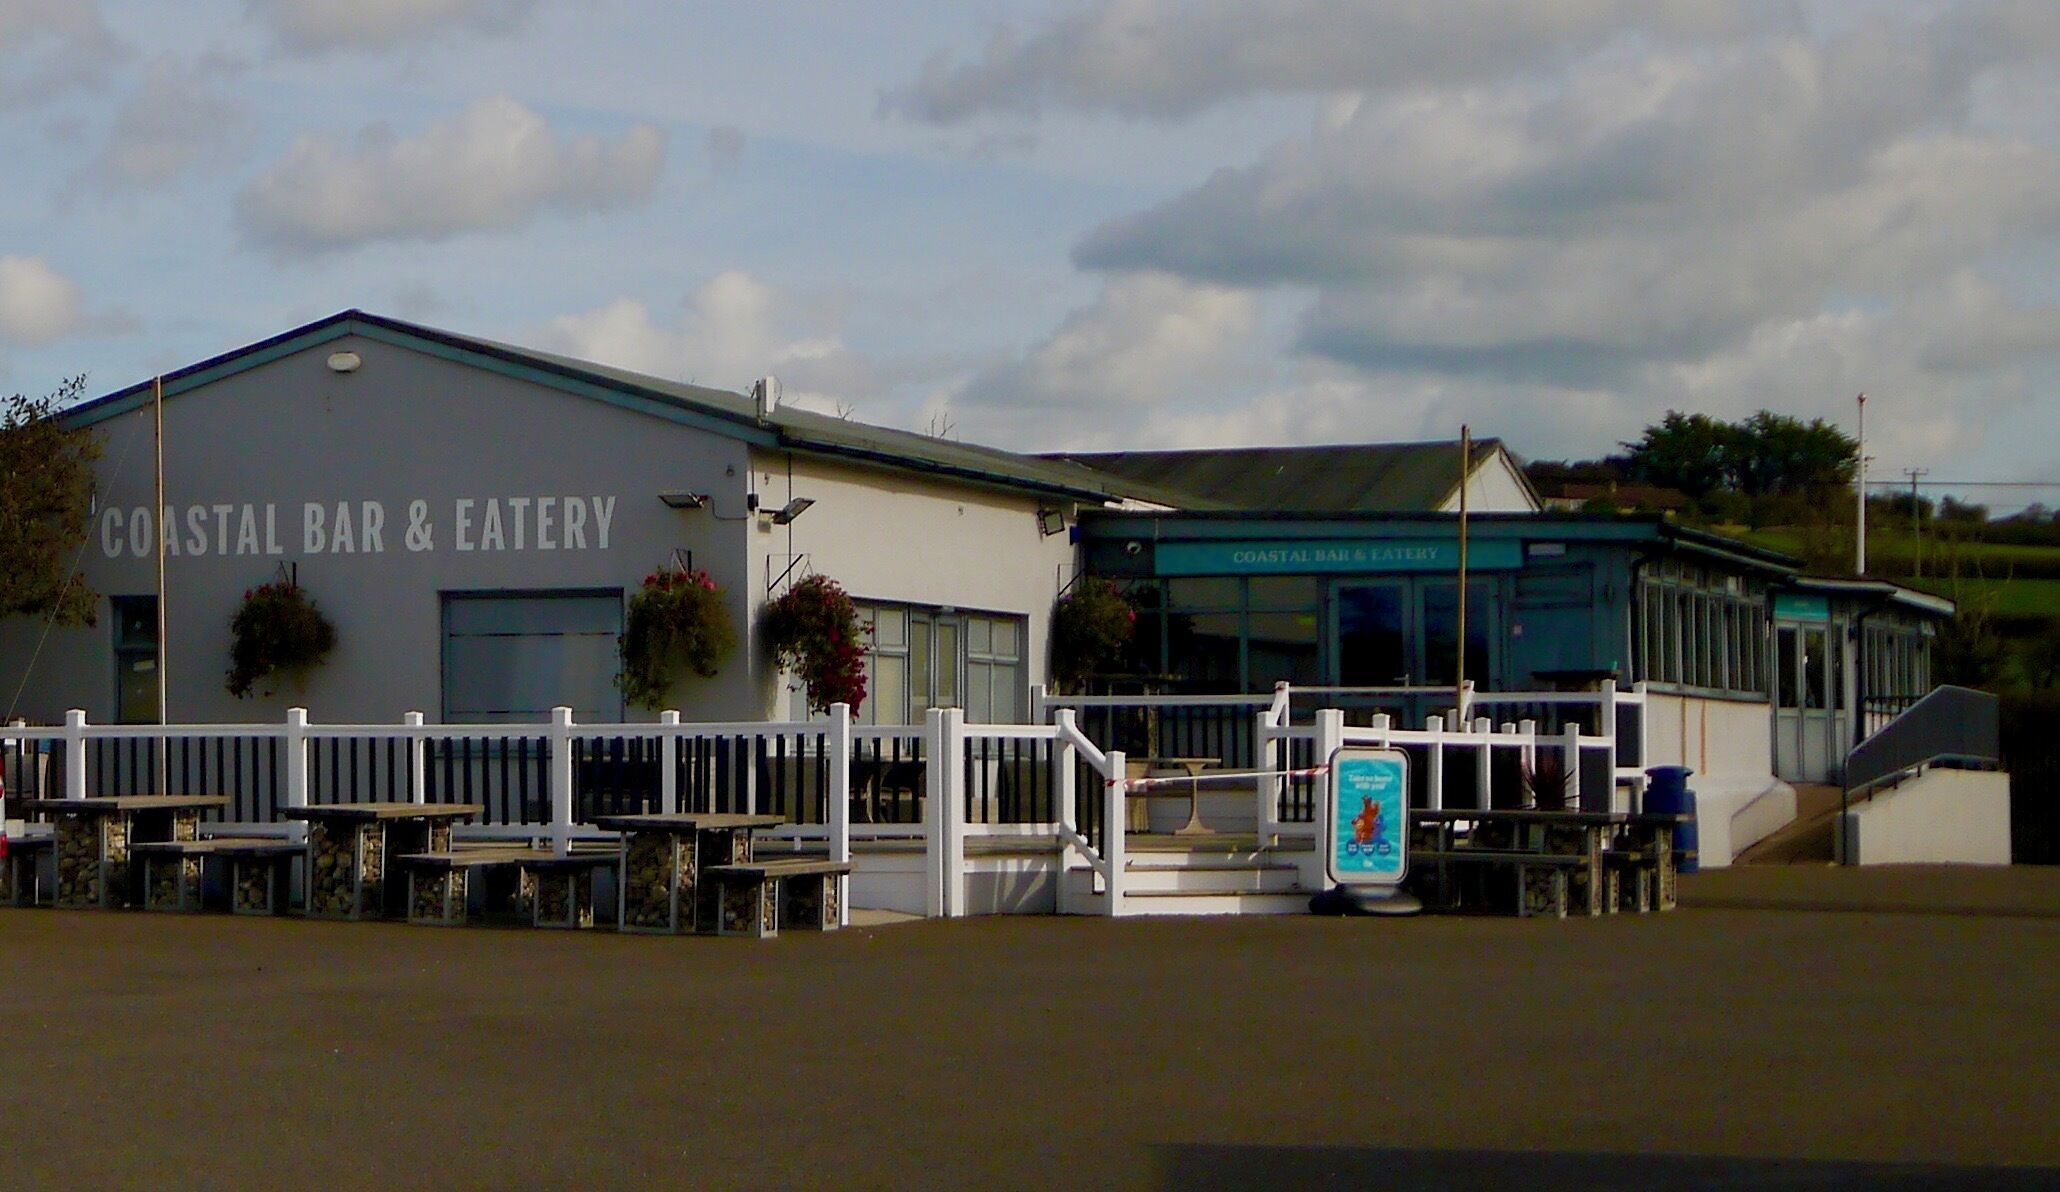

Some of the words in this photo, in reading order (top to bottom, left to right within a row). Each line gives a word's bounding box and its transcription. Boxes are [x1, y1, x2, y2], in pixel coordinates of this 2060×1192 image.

[101, 503, 283, 558] COASTAL
[303, 501, 385, 554] BAR
[405, 499, 433, 551] &
[456, 496, 616, 551] EATERY
[1233, 550, 1311, 564] COASTAL
[1315, 549, 1349, 562] BAR
[1354, 549, 1366, 561] &
[1372, 547, 1439, 561] EATERY
